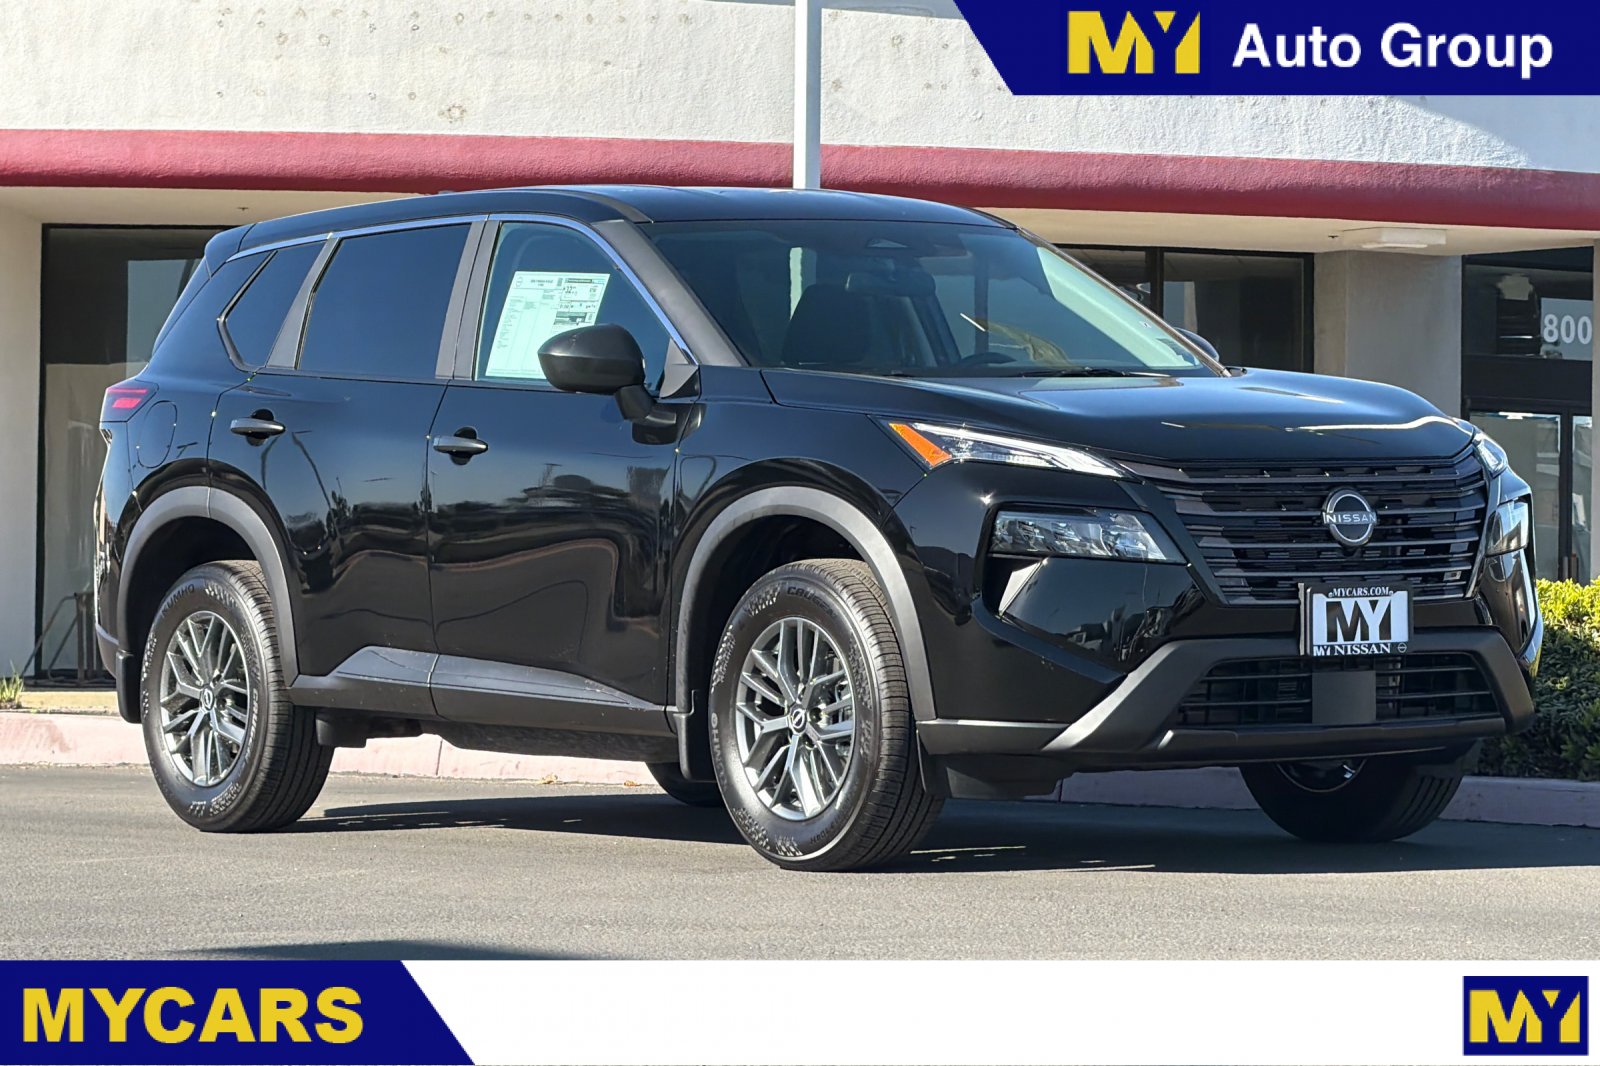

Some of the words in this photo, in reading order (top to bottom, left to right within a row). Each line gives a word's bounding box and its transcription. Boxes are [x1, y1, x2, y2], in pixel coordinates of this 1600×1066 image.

[1543, 314, 1592, 345] 800
[1325, 511, 1377, 524] NISSAN
[1331, 586, 1390, 598] MYCARS.COM
[1326, 599, 1392, 643] MY
[1333, 642, 1391, 656] NISSAN
